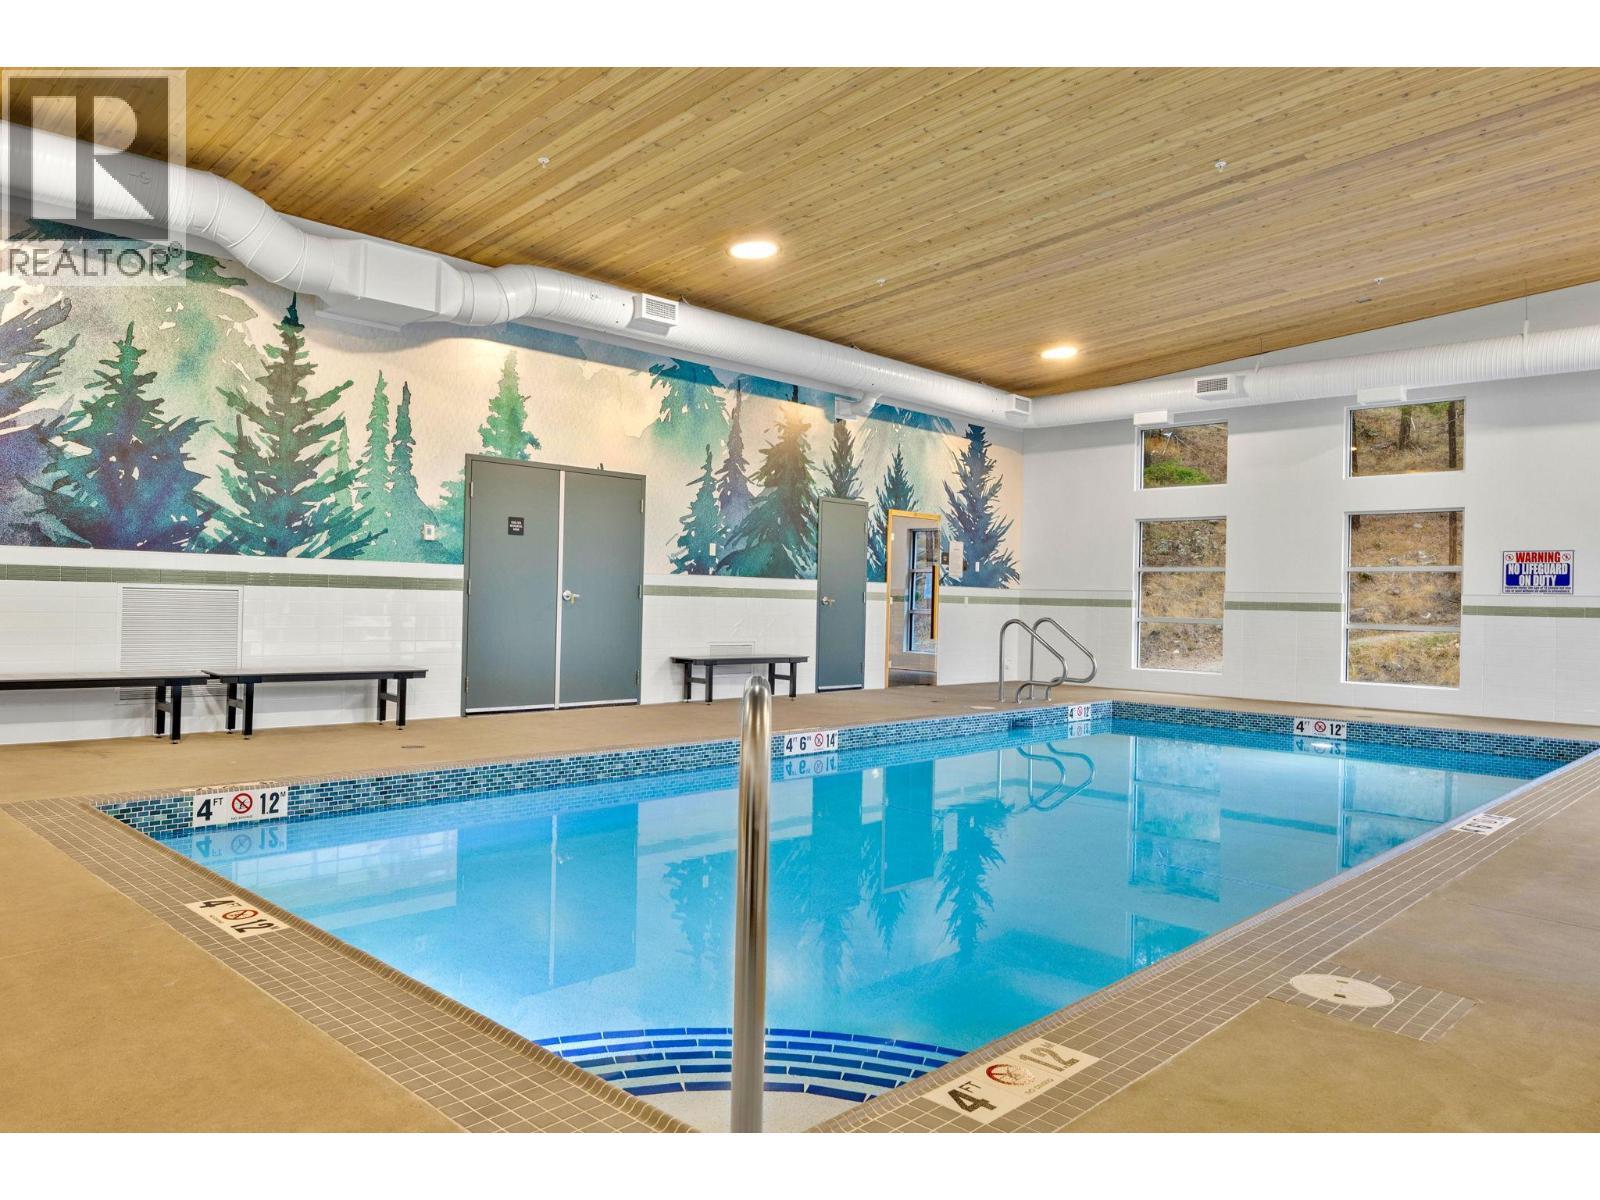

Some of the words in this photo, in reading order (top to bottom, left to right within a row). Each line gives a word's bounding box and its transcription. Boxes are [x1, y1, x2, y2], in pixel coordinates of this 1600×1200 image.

[1515, 551, 1561, 563] WARNING
[1508, 563, 1520, 575] NO
[1522, 563, 1568, 575] LIFEGUARD
[1519, 574, 1531, 586] ON
[1533, 574, 1557, 586] DUTY
